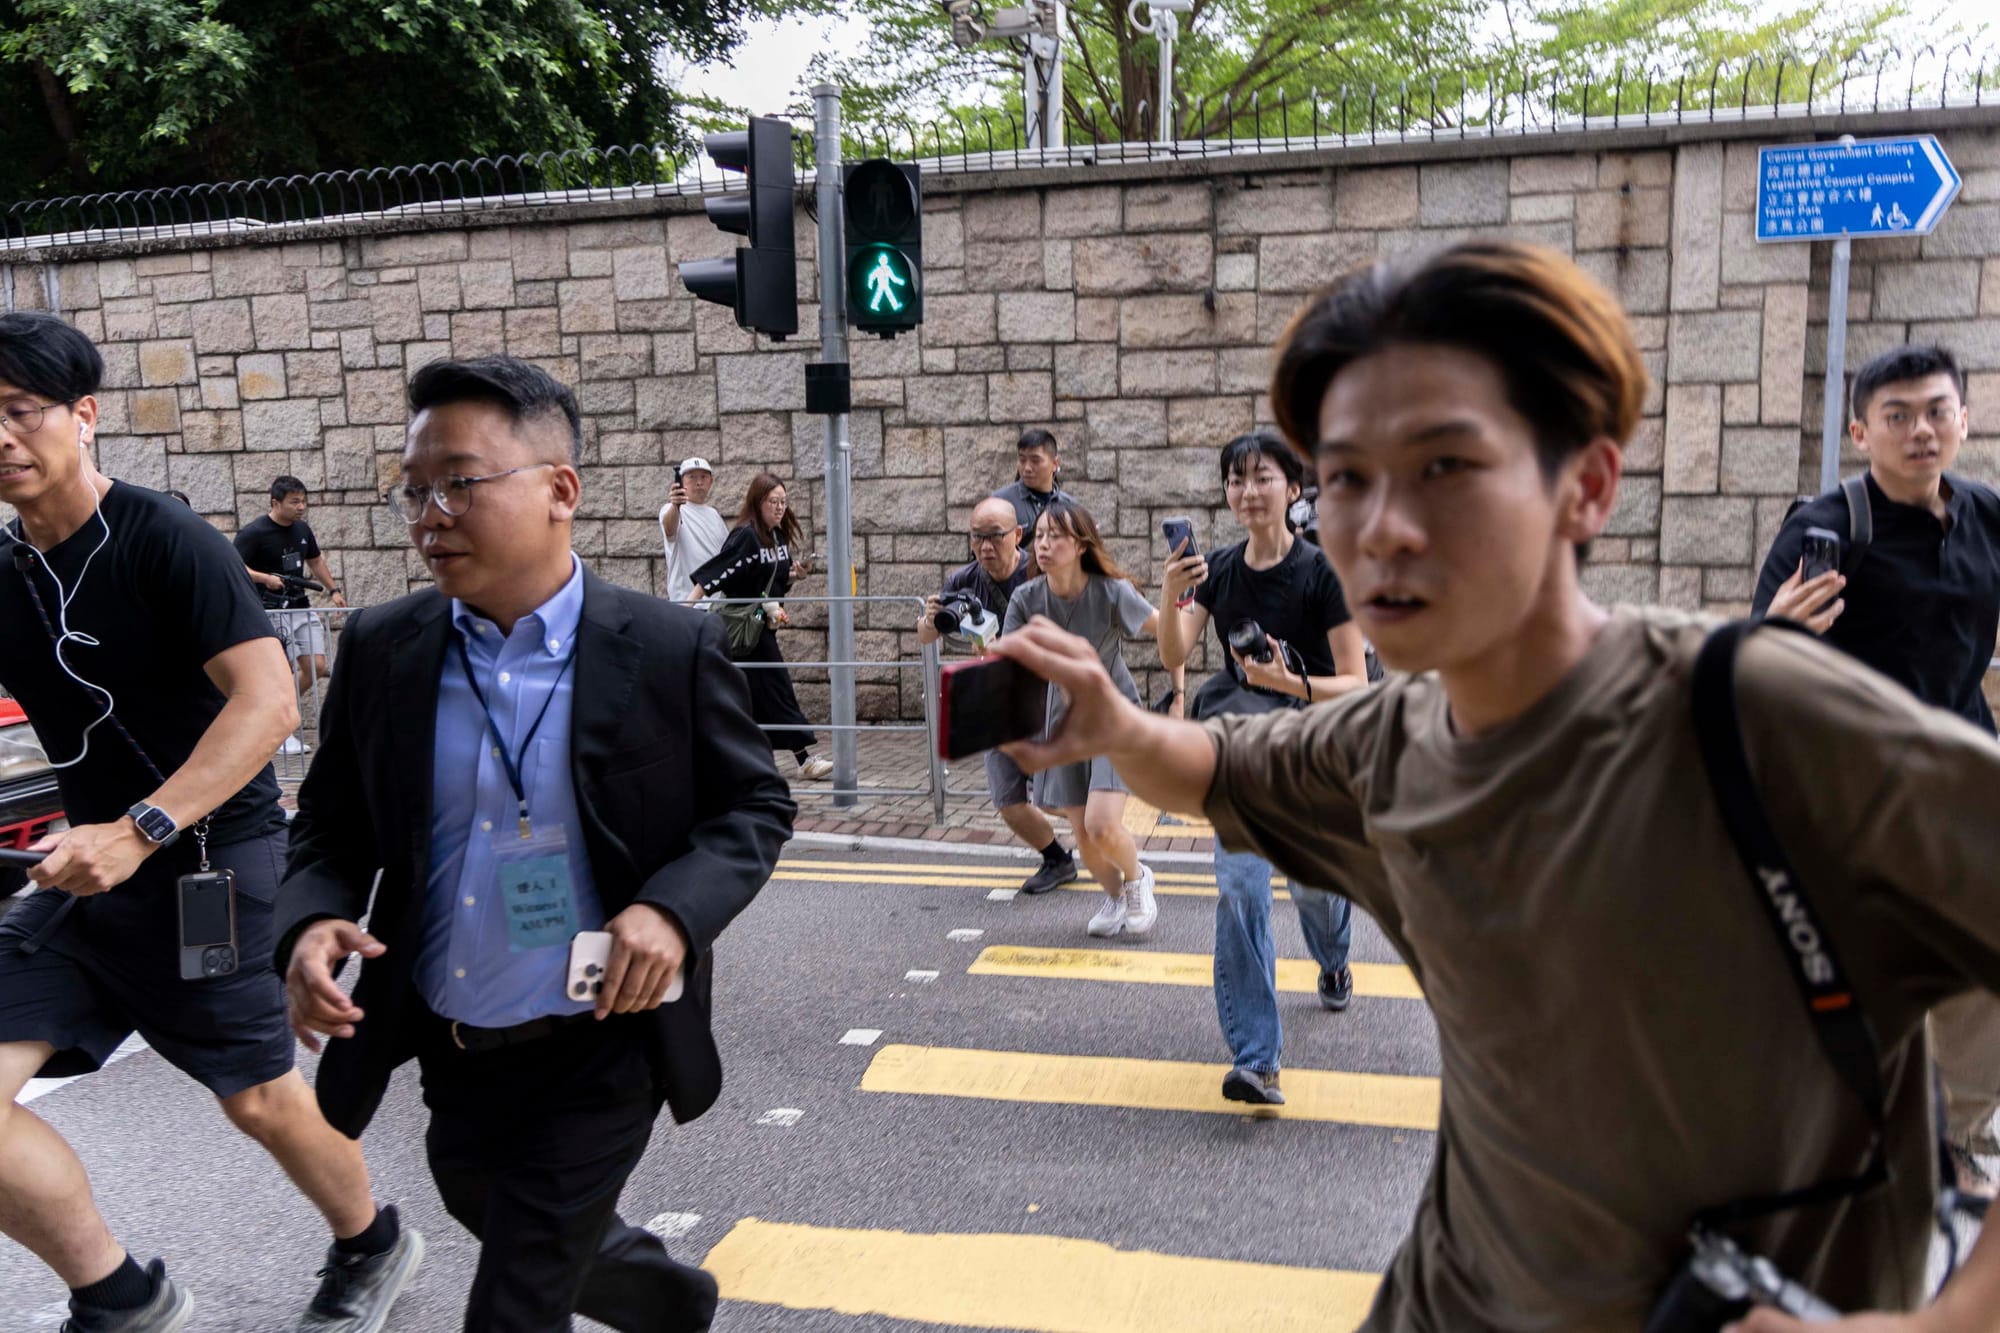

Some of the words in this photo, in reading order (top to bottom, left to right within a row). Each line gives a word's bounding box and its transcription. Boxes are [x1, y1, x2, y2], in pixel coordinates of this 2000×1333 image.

[1766, 149, 1805, 164] Central
[1808, 145, 1872, 162] Government
[1875, 142, 1915, 158] Offices
[1765, 176, 1821, 192] Legislative
[1823, 173, 1864, 188] Council
[1867, 171, 1915, 186] Complex
[1765, 206, 1795, 219] Tamar
[1799, 204, 1821, 217] Park
[1757, 867, 1835, 984] SONY
